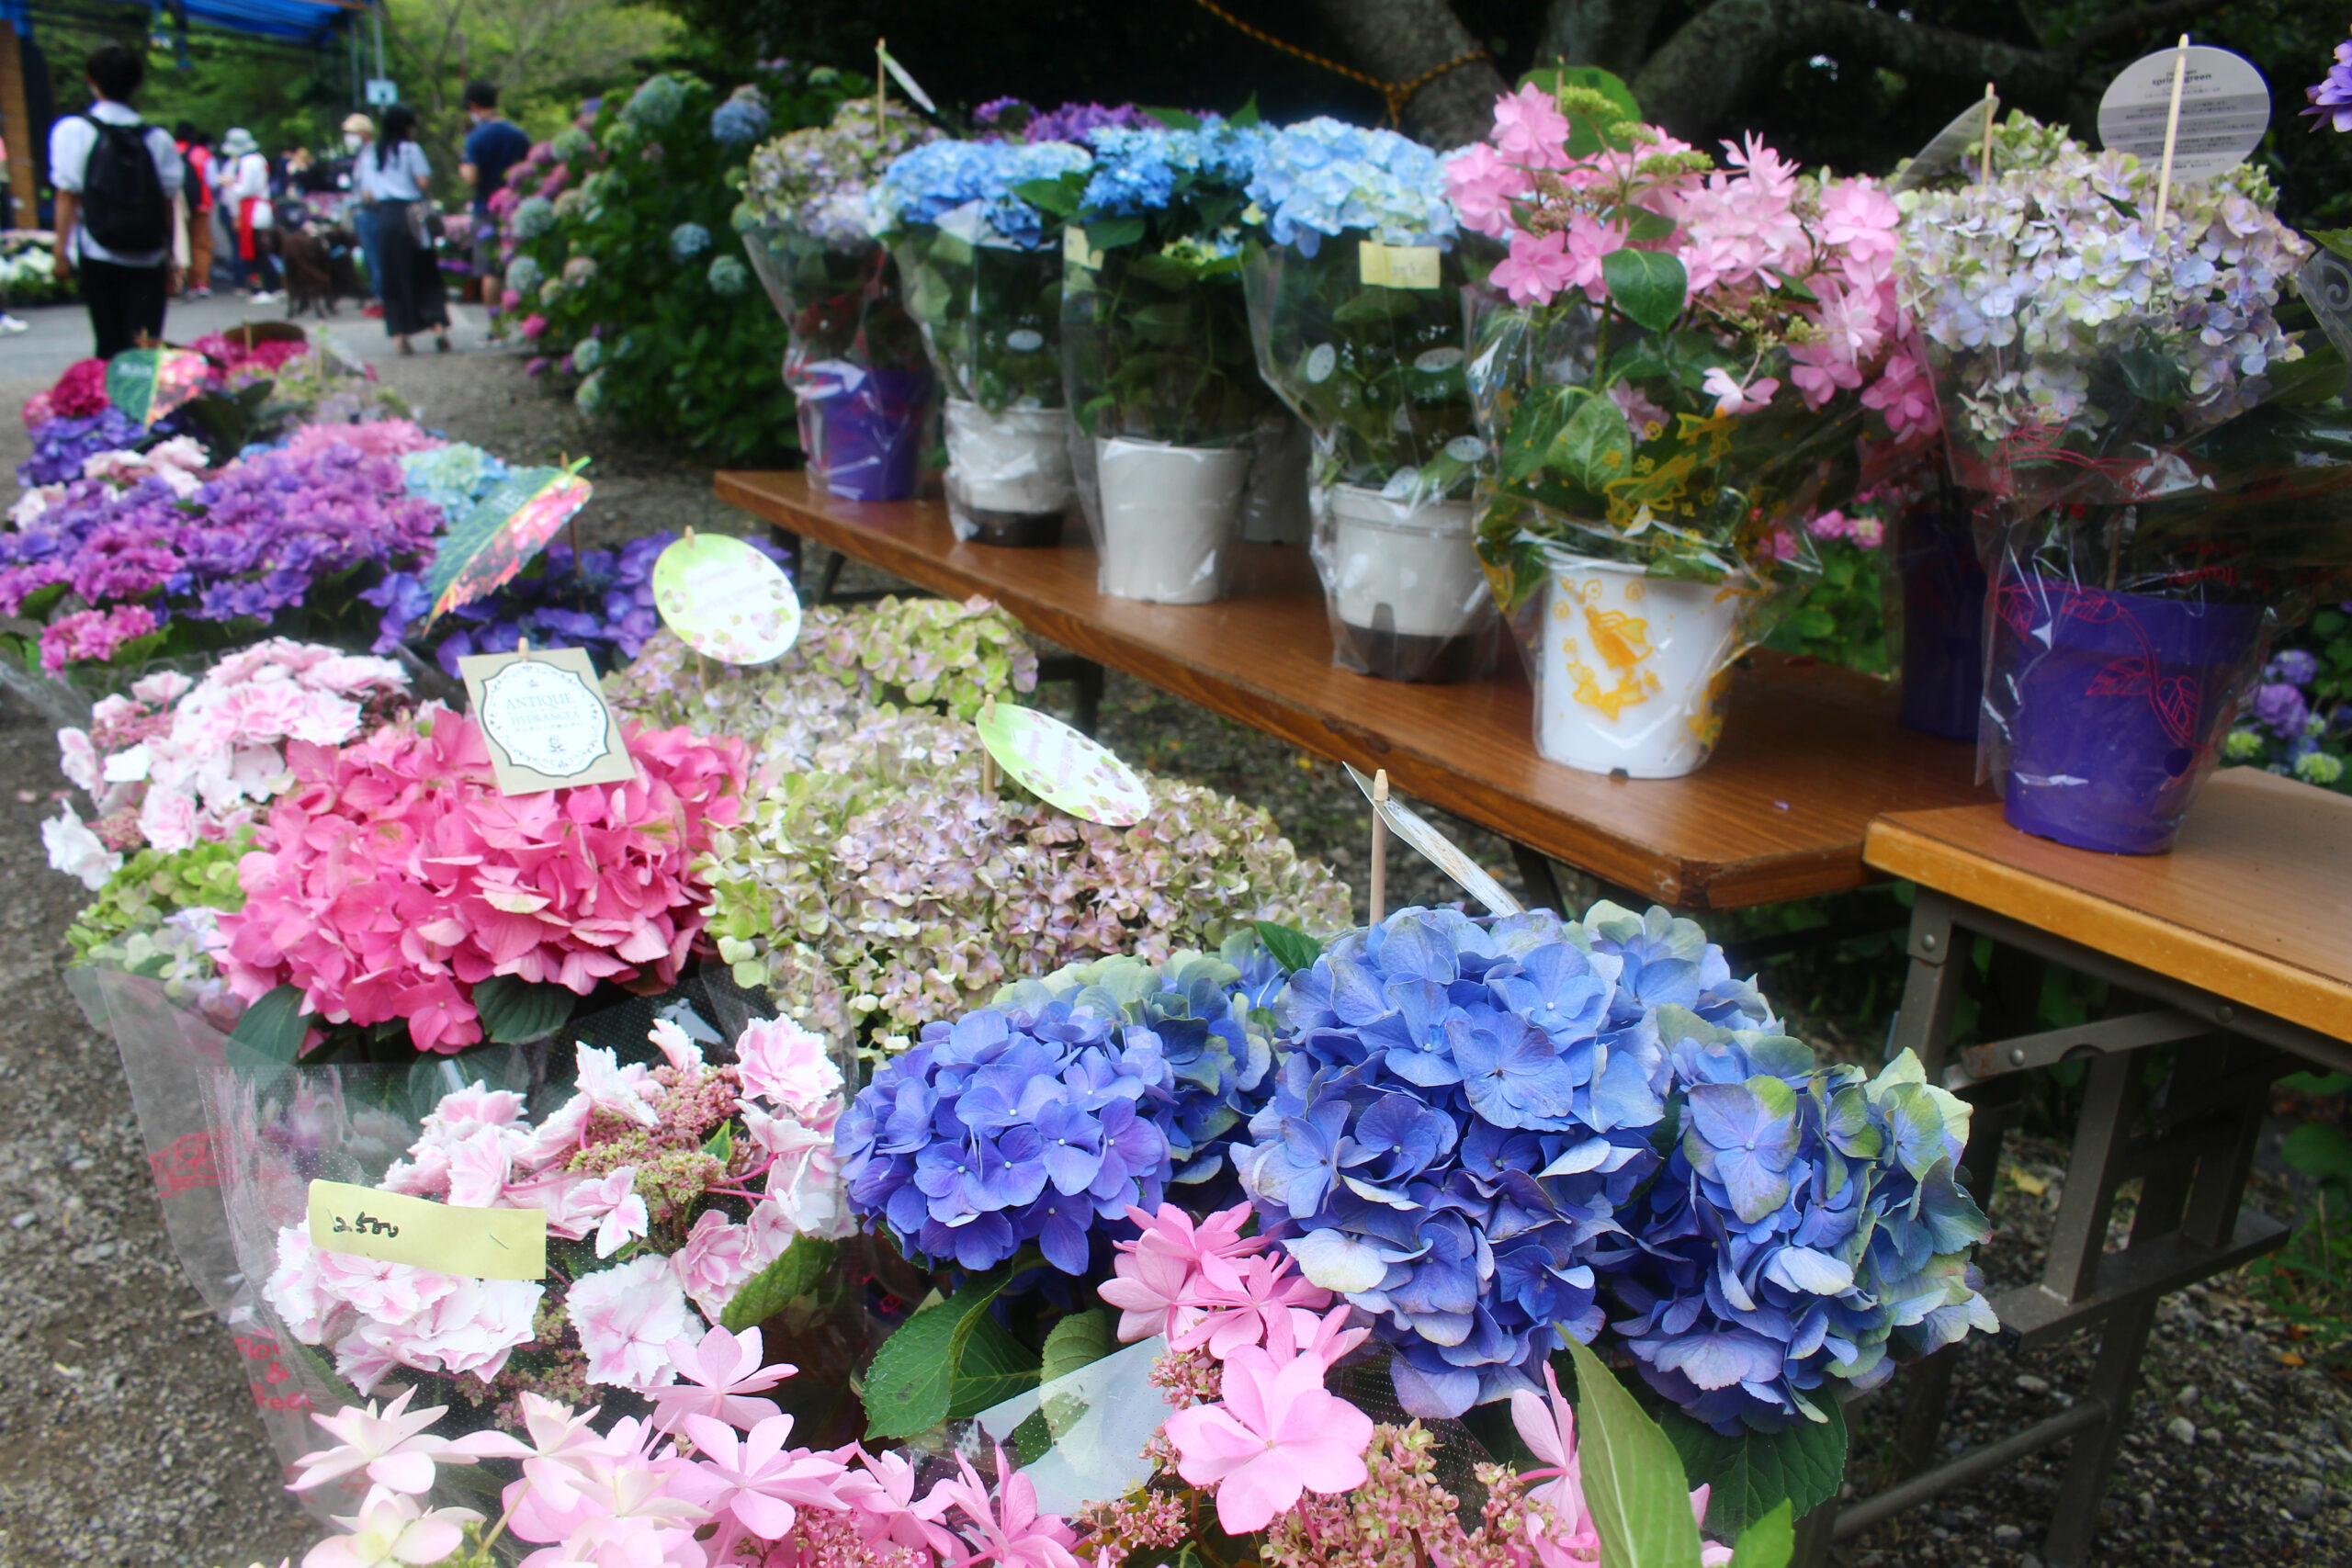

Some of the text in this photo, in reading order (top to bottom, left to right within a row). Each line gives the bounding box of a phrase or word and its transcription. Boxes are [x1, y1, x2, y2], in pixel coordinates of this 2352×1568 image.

[2184, 73, 2211, 84] green
[506, 692, 573, 711] ANTIQUE
[266, 1361, 290, 1385] &
